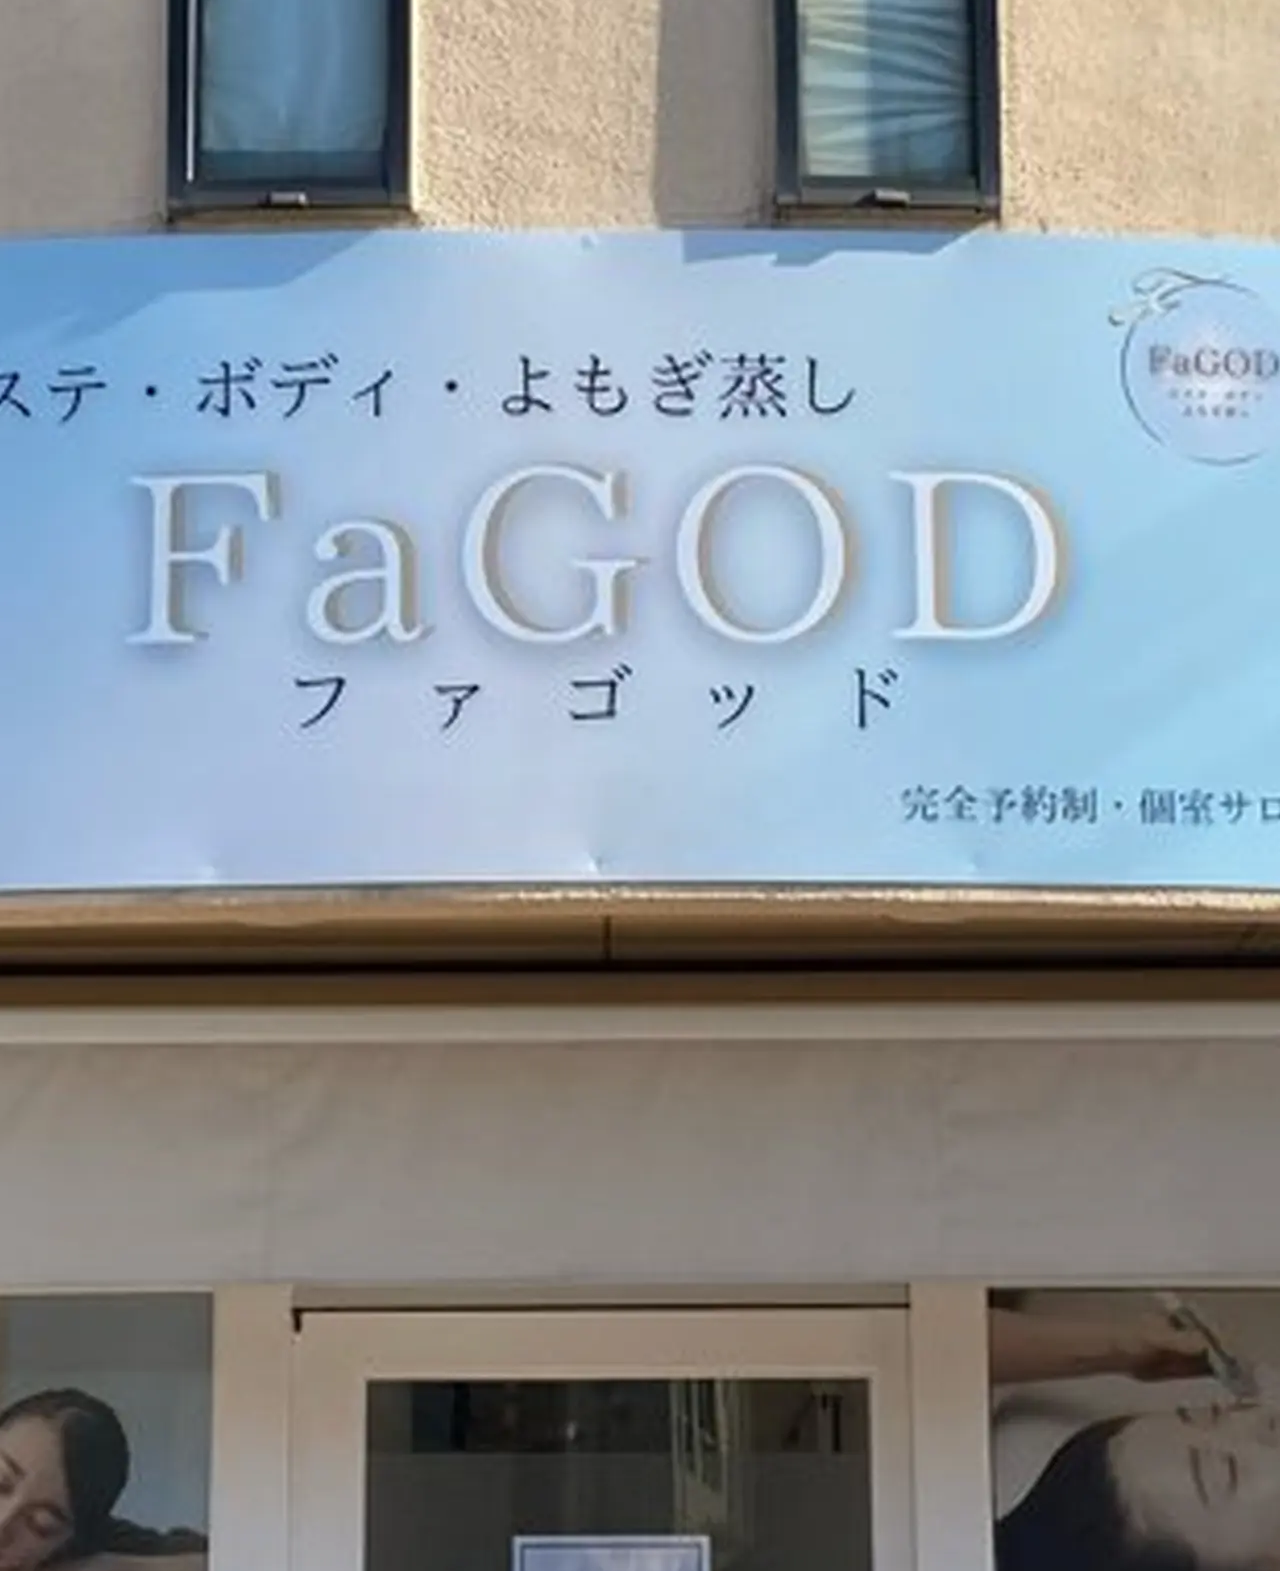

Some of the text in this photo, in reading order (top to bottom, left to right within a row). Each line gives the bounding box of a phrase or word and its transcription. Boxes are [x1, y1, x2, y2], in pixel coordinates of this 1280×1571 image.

[125, 463, 1067, 648] FaGOD
[296, 664, 898, 731] ファゴッド
